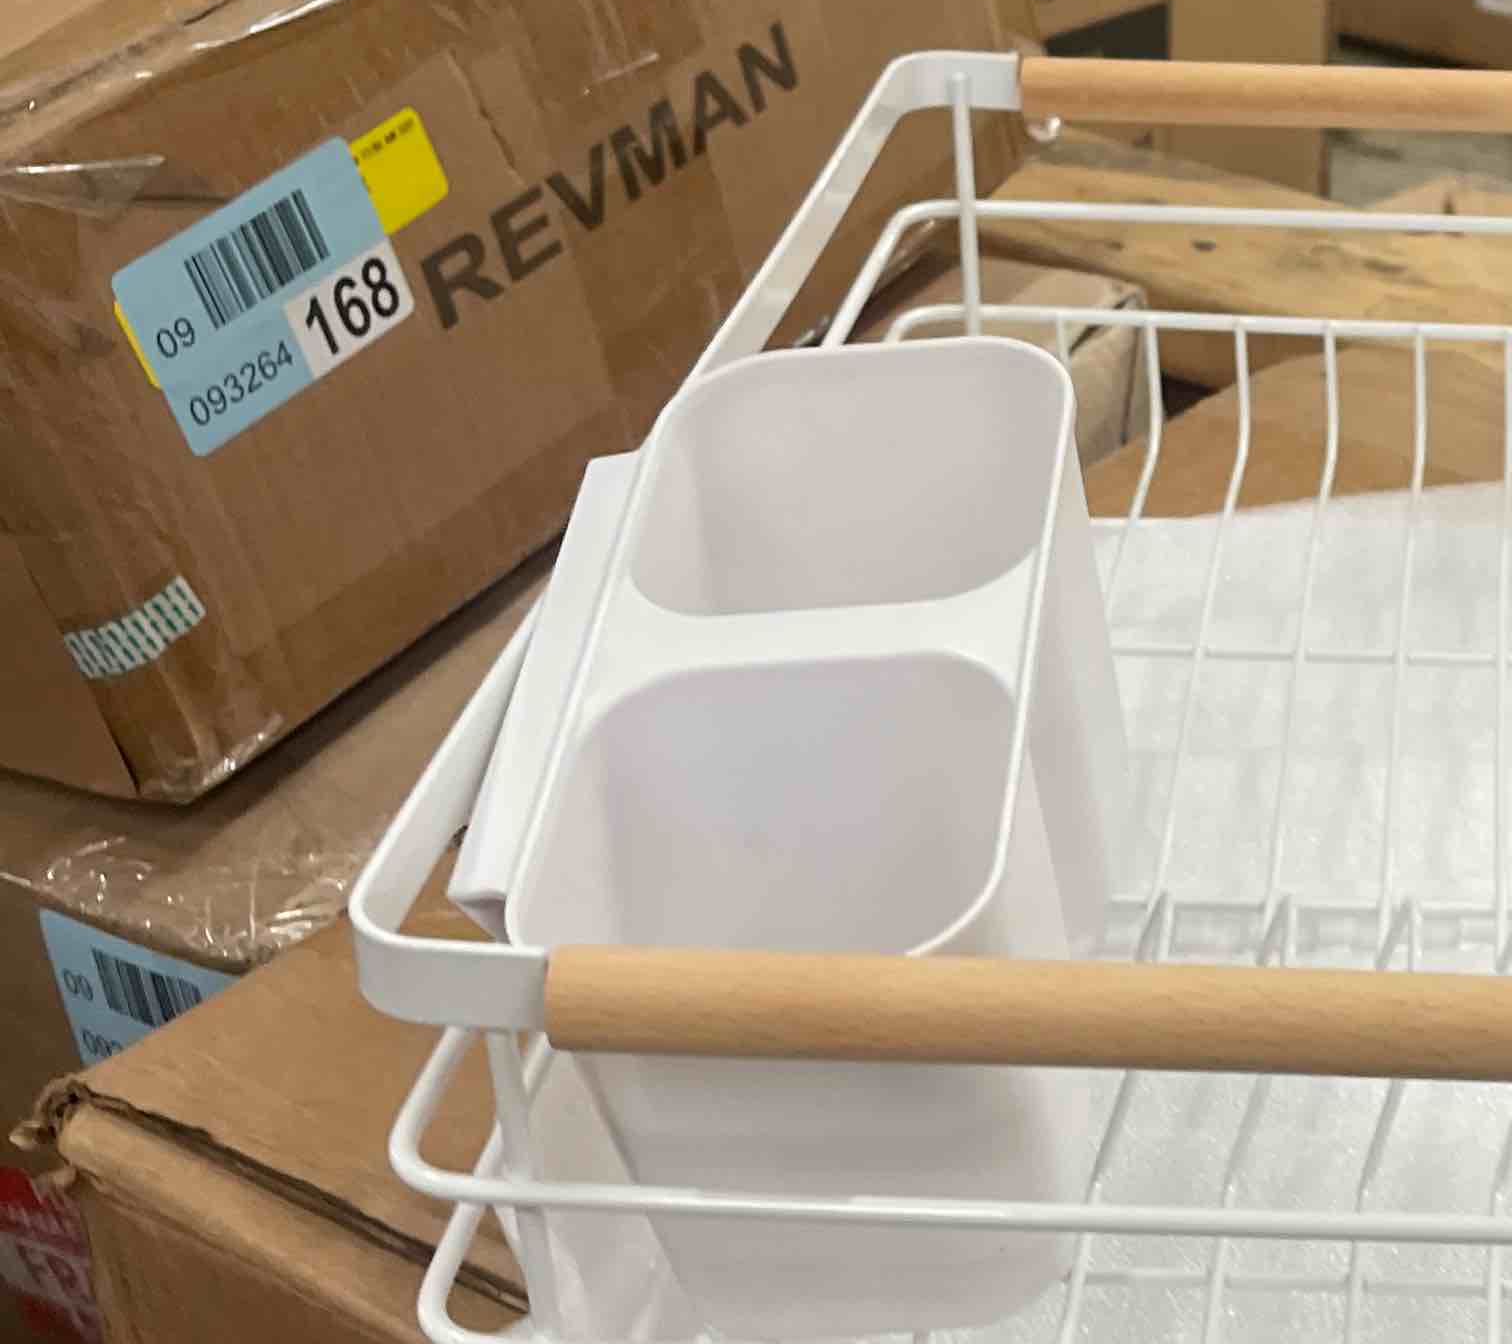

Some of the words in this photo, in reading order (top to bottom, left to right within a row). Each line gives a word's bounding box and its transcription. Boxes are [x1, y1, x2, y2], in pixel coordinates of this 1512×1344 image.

[418, 20, 802, 331] REVMAN
[156, 314, 197, 360] 09
[304, 256, 403, 359] 168
[188, 339, 295, 429] 093264
